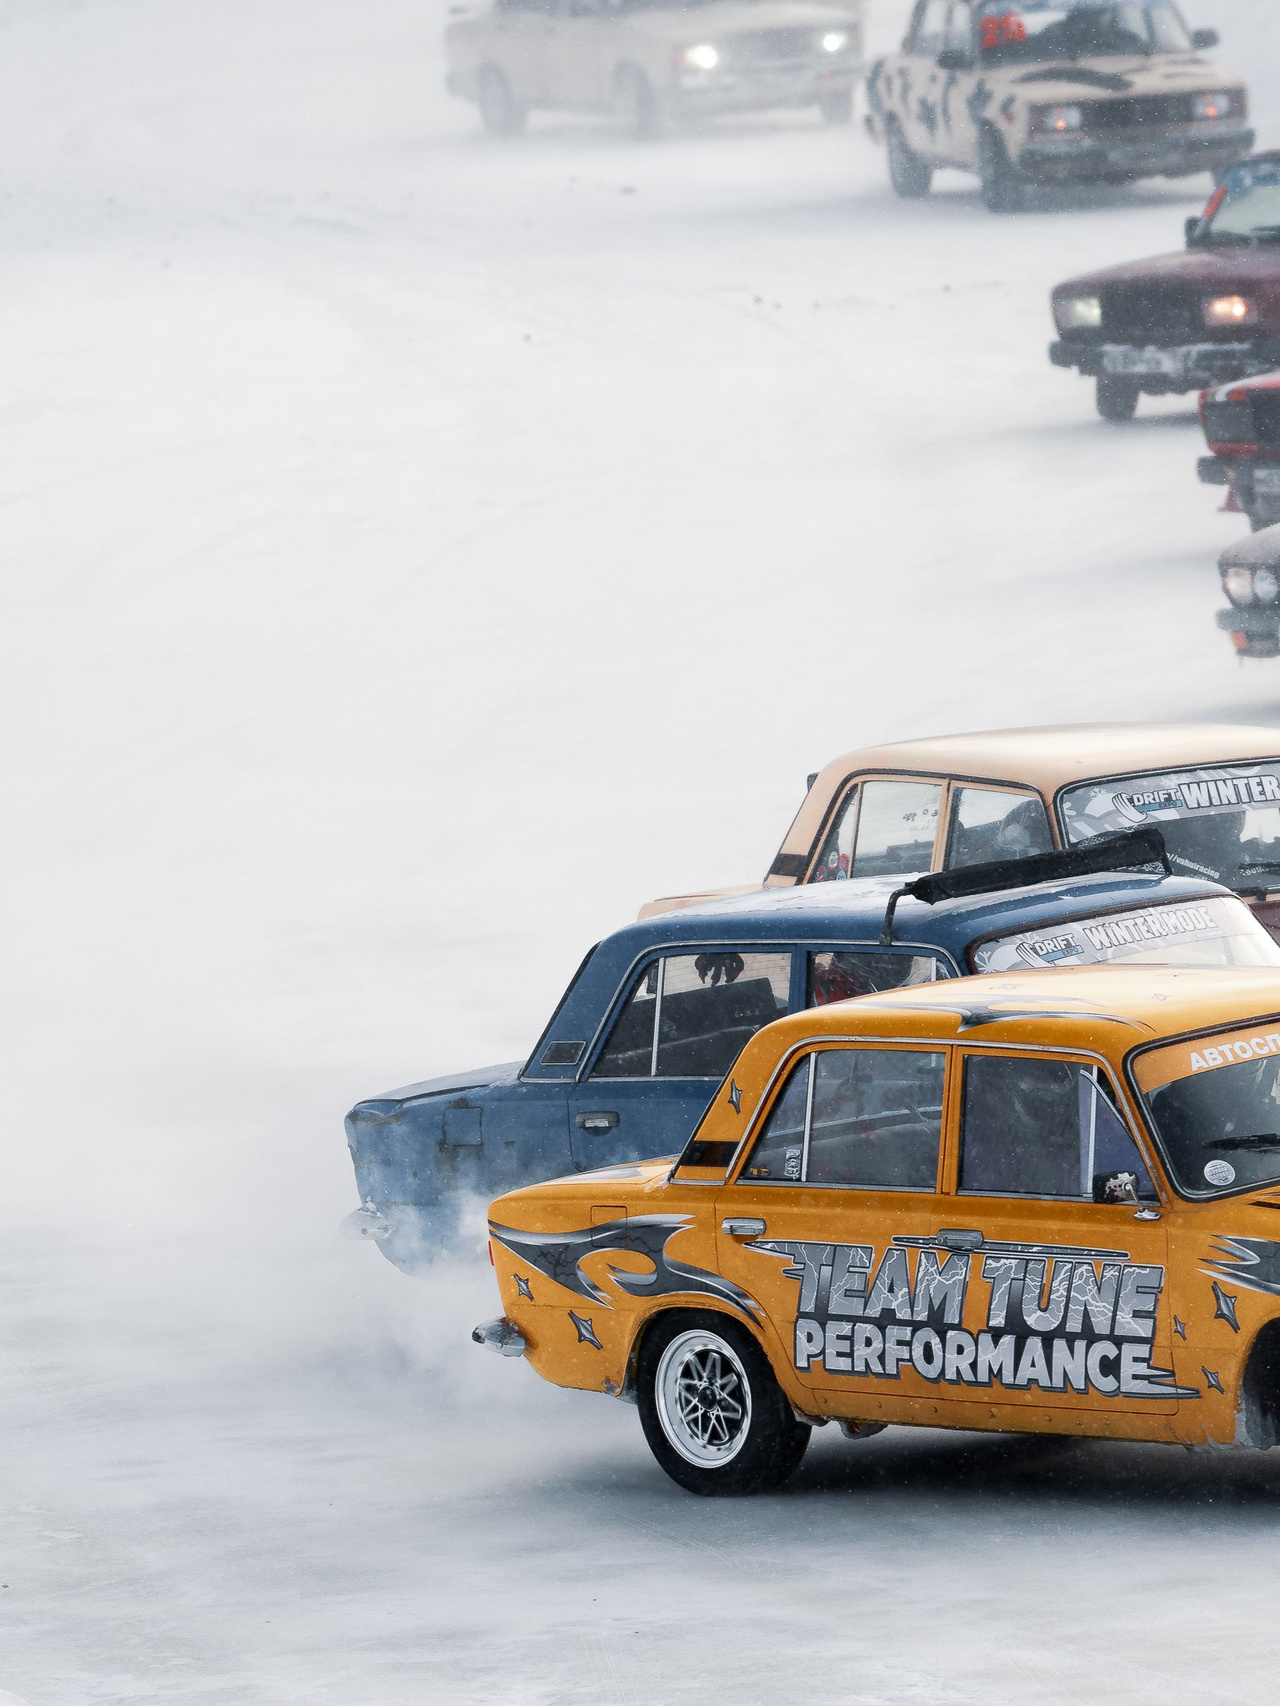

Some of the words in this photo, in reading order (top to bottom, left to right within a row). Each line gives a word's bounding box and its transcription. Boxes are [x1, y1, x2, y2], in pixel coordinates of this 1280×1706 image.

[1132, 788, 1179, 807] DRIFT
[1034, 933, 1076, 957] DRIFT
[1083, 913, 1168, 951] WINTER
[1163, 905, 1220, 936] MODE
[778, 1243, 971, 1326] TEAM
[982, 1253, 1166, 1338] TUNE
[794, 1317, 1165, 1397] PERFORMANCE
